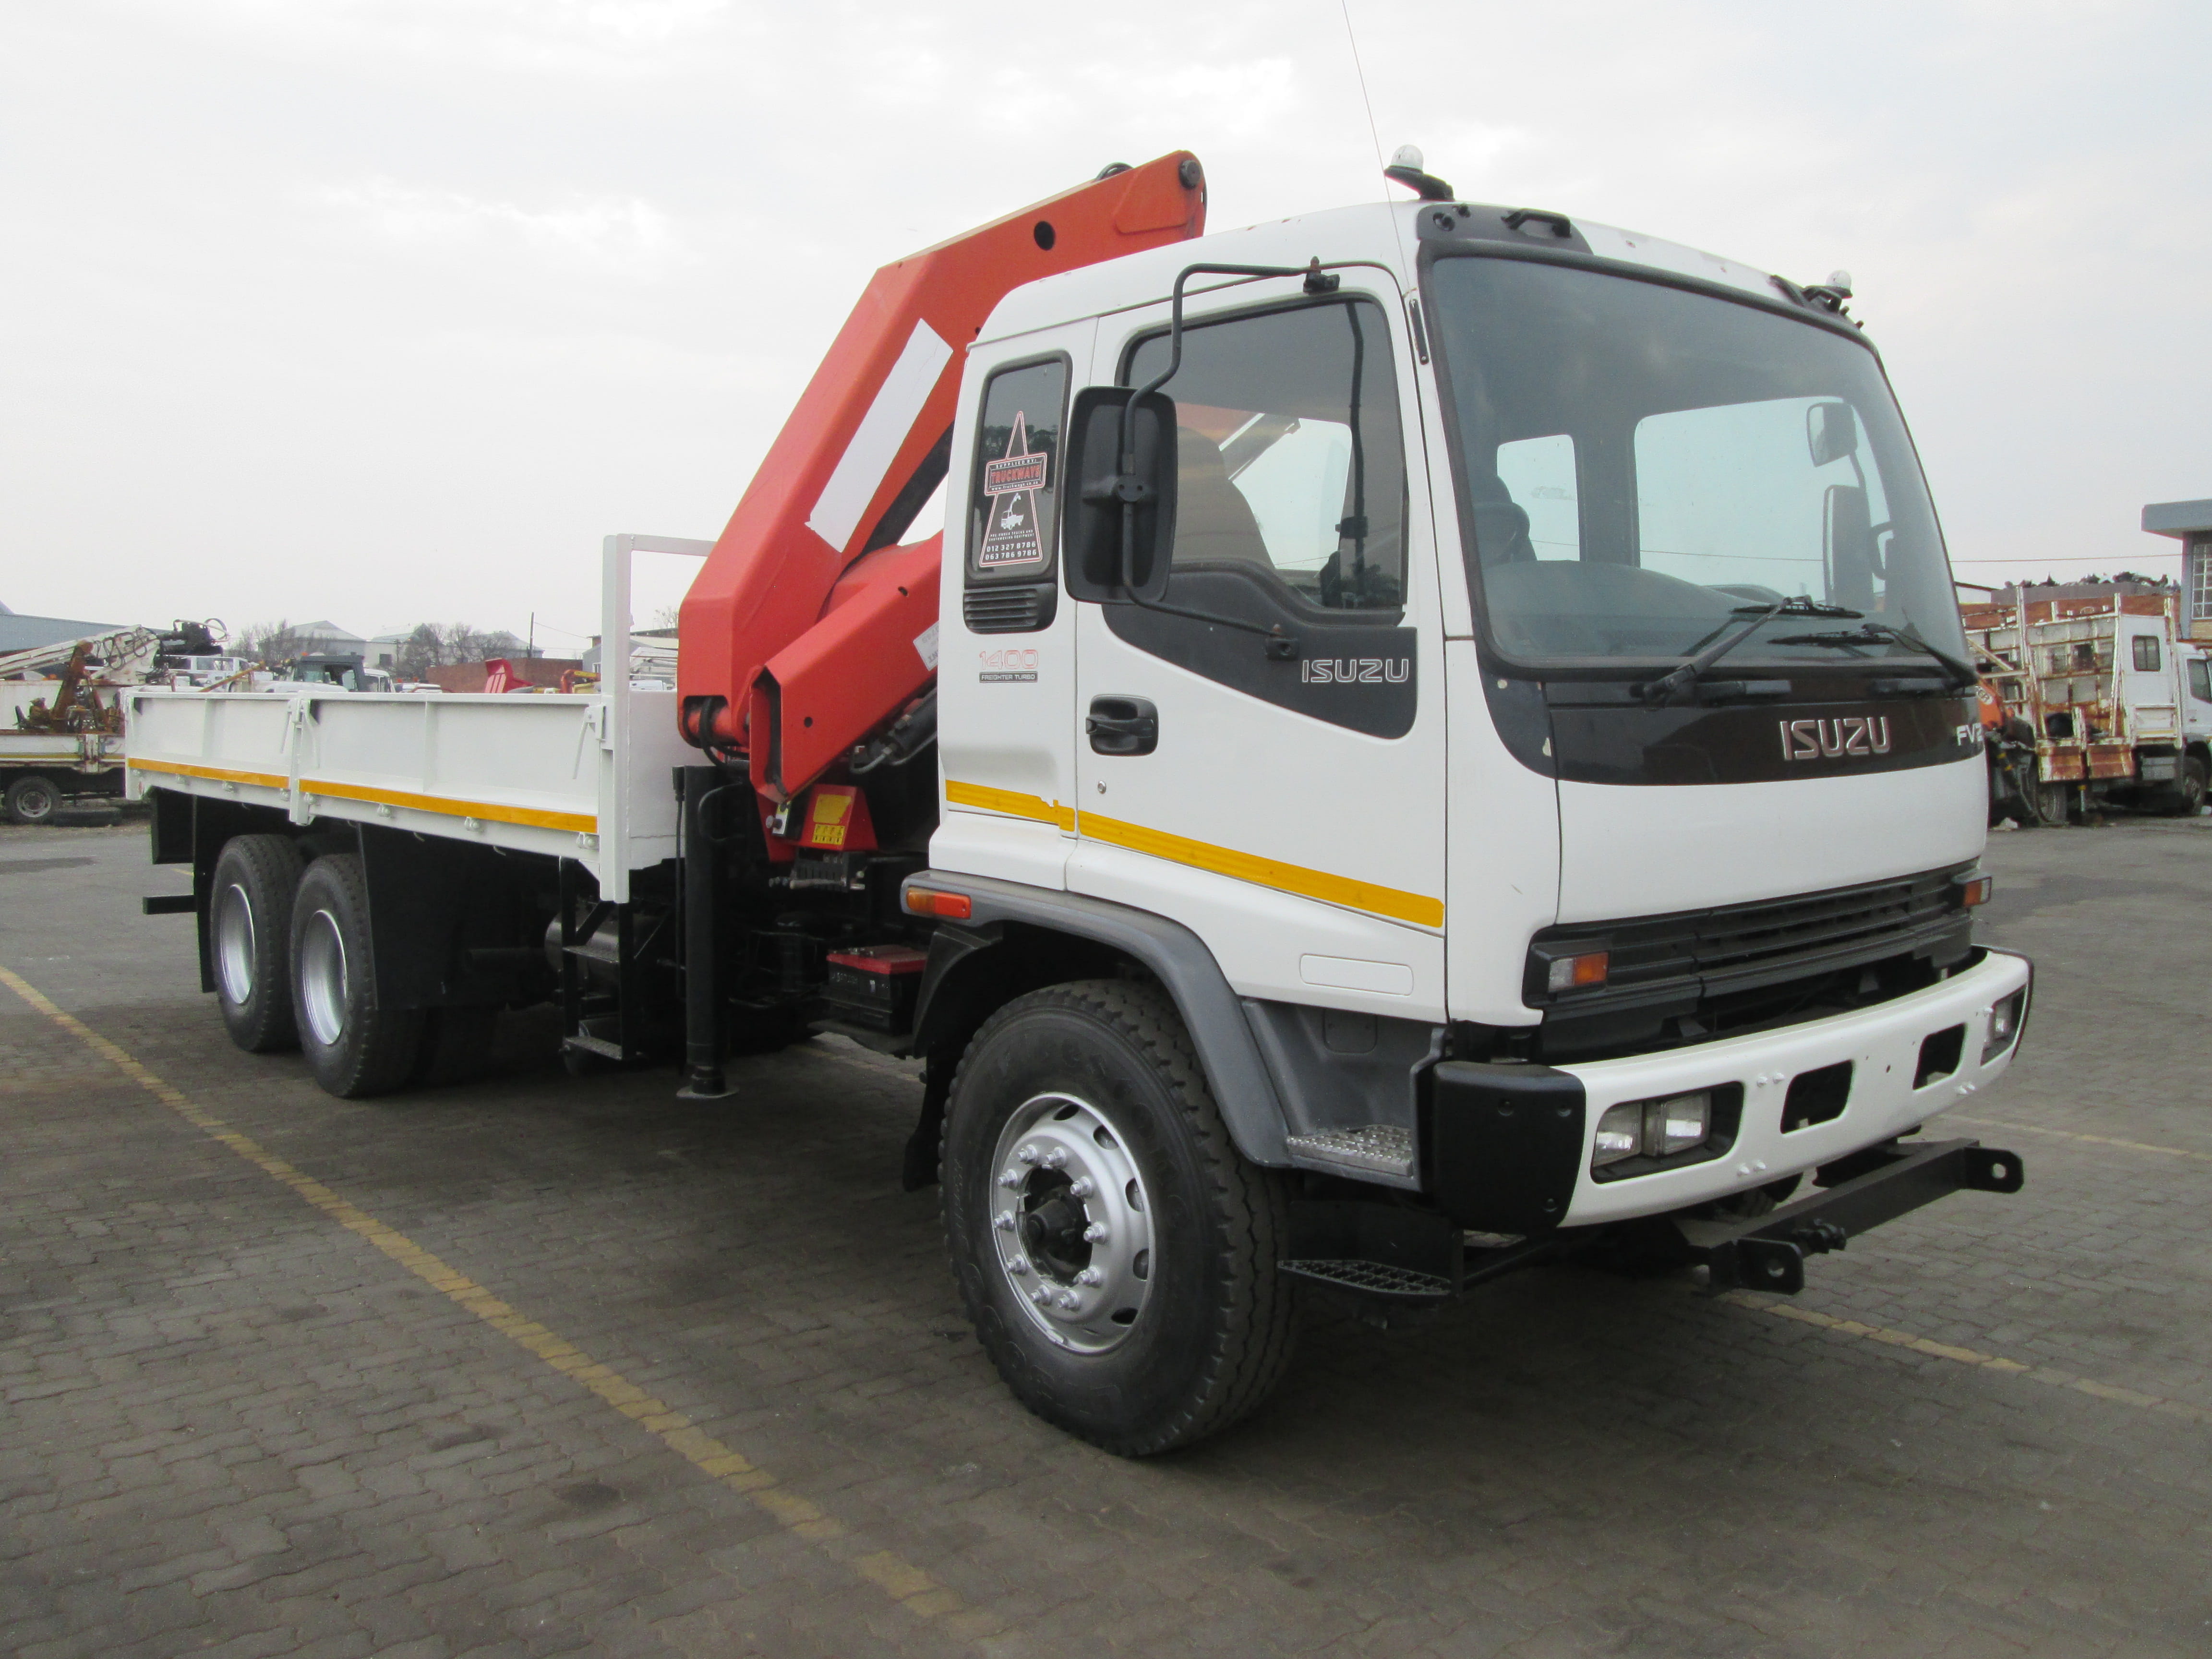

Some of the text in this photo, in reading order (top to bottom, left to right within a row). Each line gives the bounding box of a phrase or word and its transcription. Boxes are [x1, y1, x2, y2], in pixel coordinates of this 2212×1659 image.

[991, 465, 1040, 483] TRUCKWAYS
[996, 460, 1025, 469] SUPPLIED
[991, 481, 1038, 491] www.truckways.co.za
[979, 649, 1038, 670] 1400
[1302, 658, 1409, 683] ISUZU
[1779, 716, 1890, 761] ISUZU
